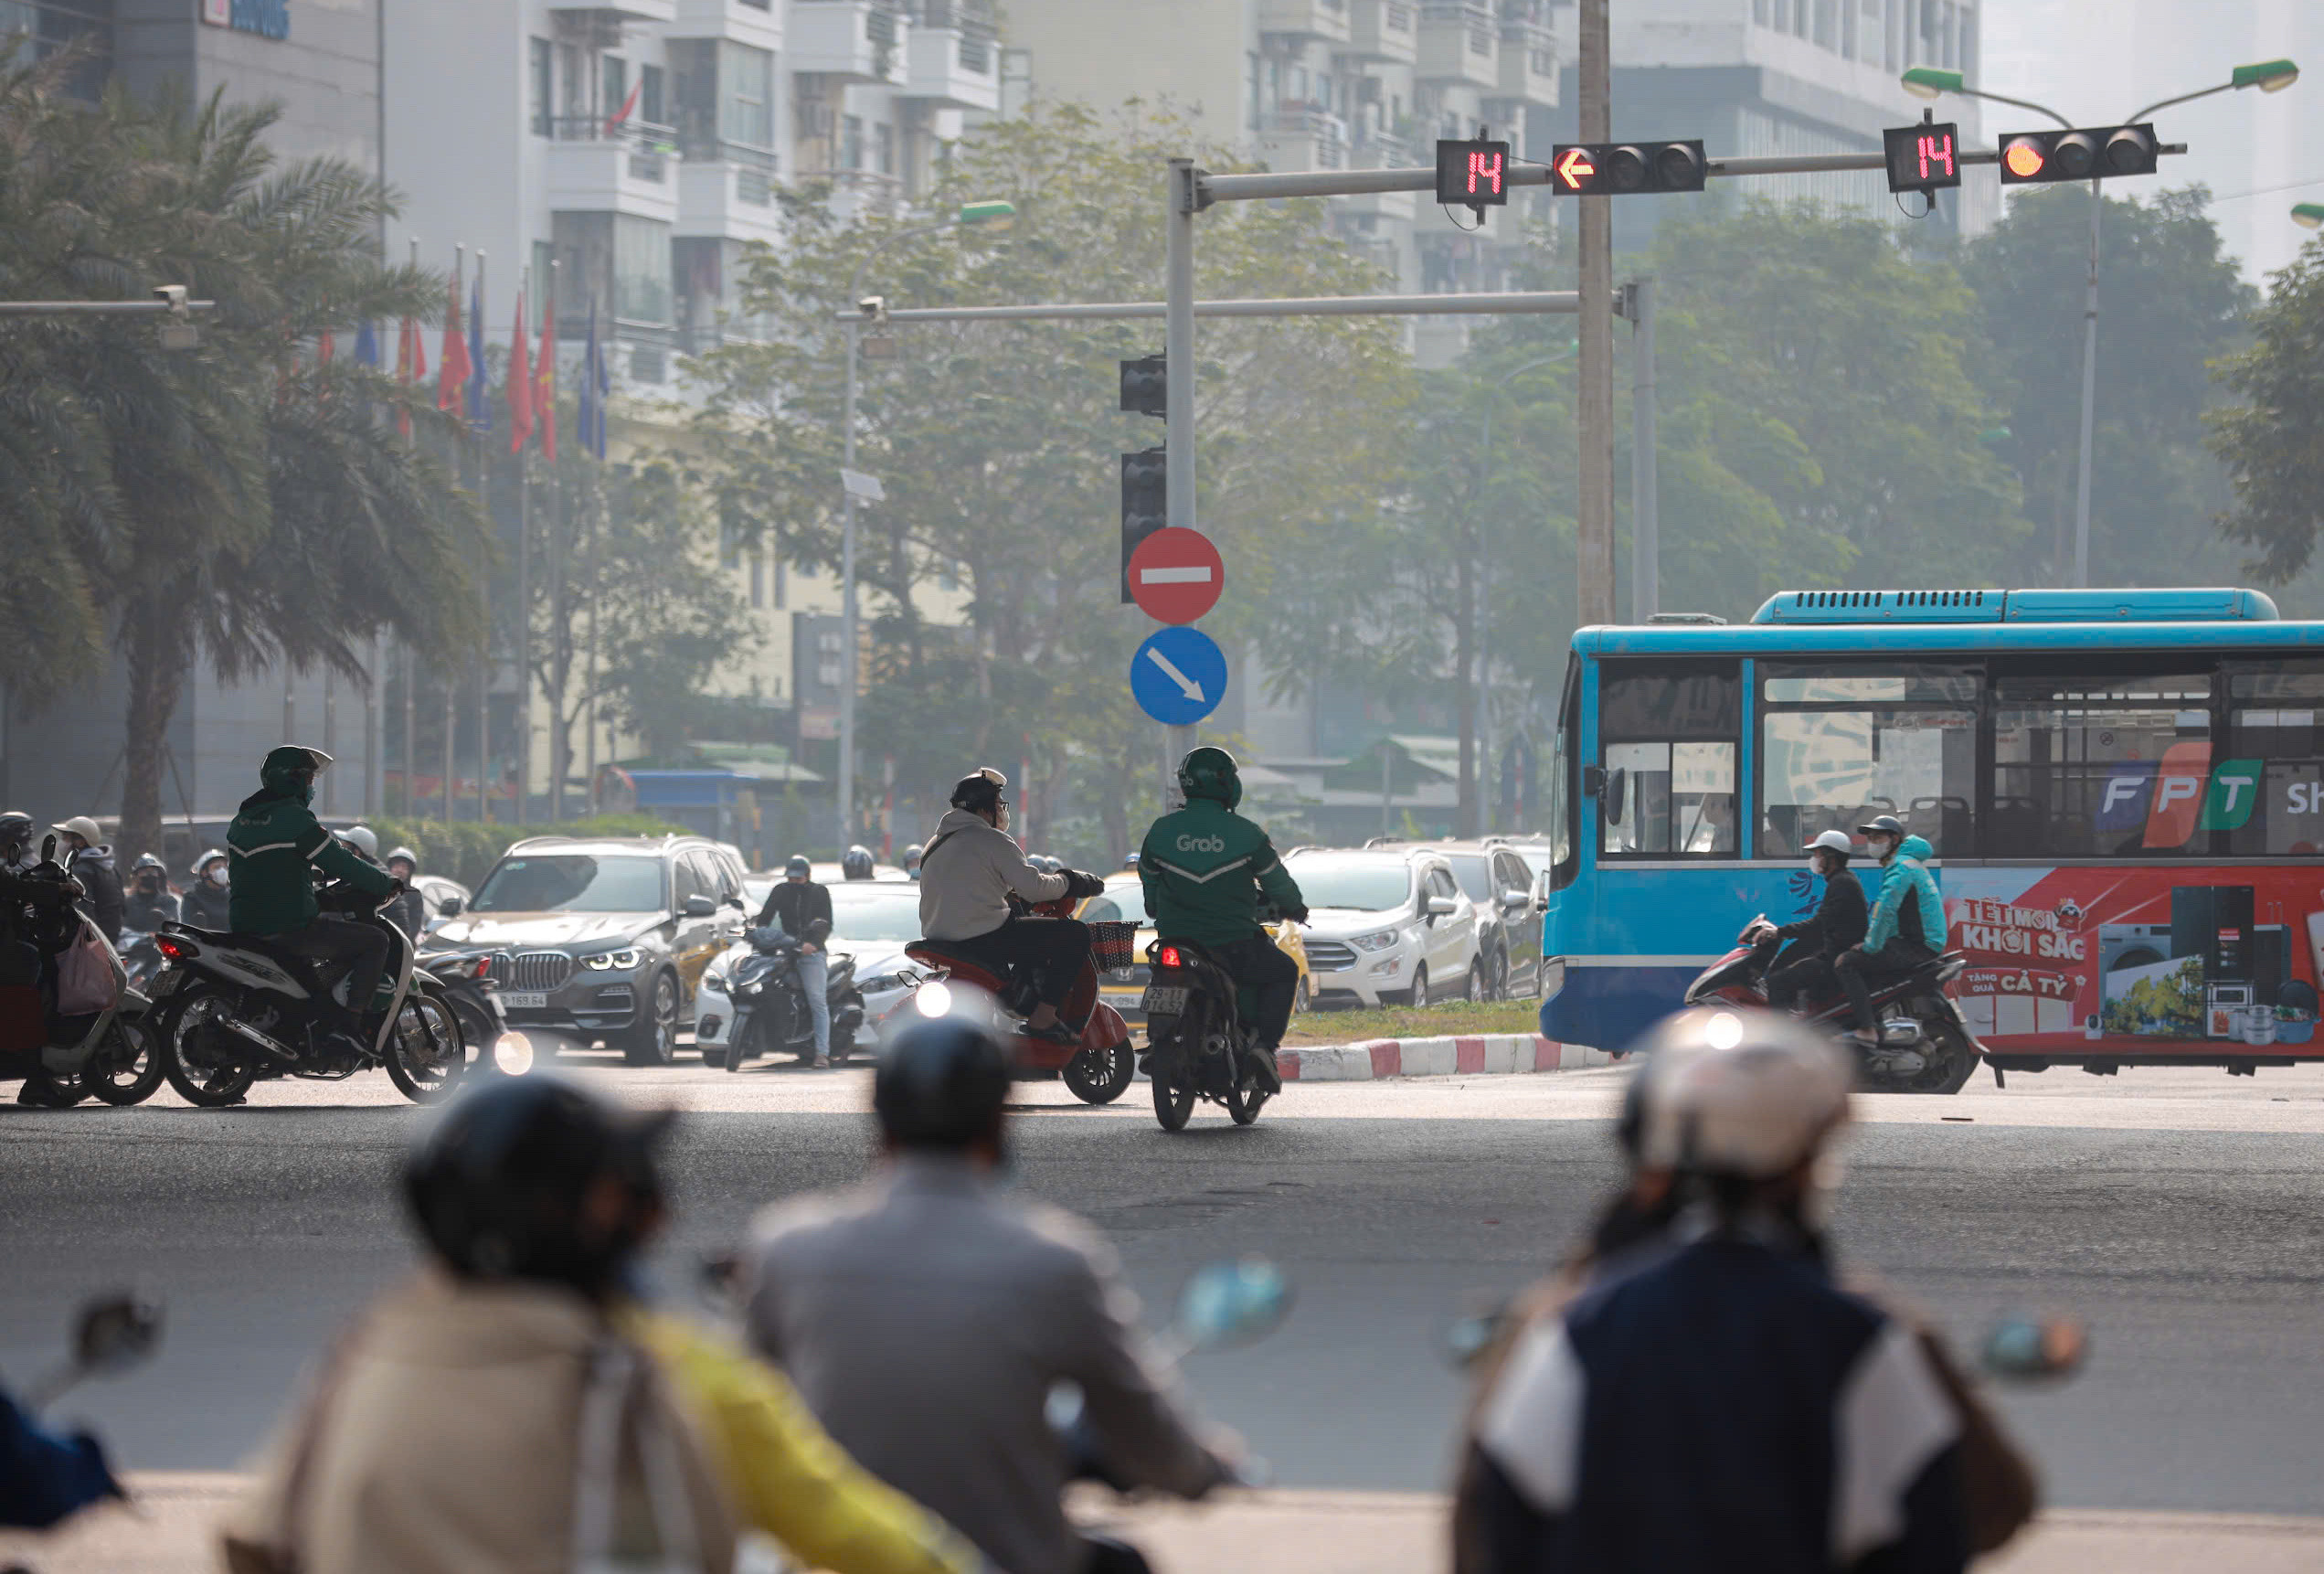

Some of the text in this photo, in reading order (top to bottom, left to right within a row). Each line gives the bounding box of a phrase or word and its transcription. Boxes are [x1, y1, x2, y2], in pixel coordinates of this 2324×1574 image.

[1917, 134, 1953, 178] 14
[1468, 152, 1502, 194] 14
[2103, 777, 2254, 814] FPT
[1176, 834, 1226, 853] Grab
[1964, 897, 2011, 925] TẾT
[1962, 924, 2032, 955] KHỞI
[2000, 969, 2067, 996] CẢ TỶ
